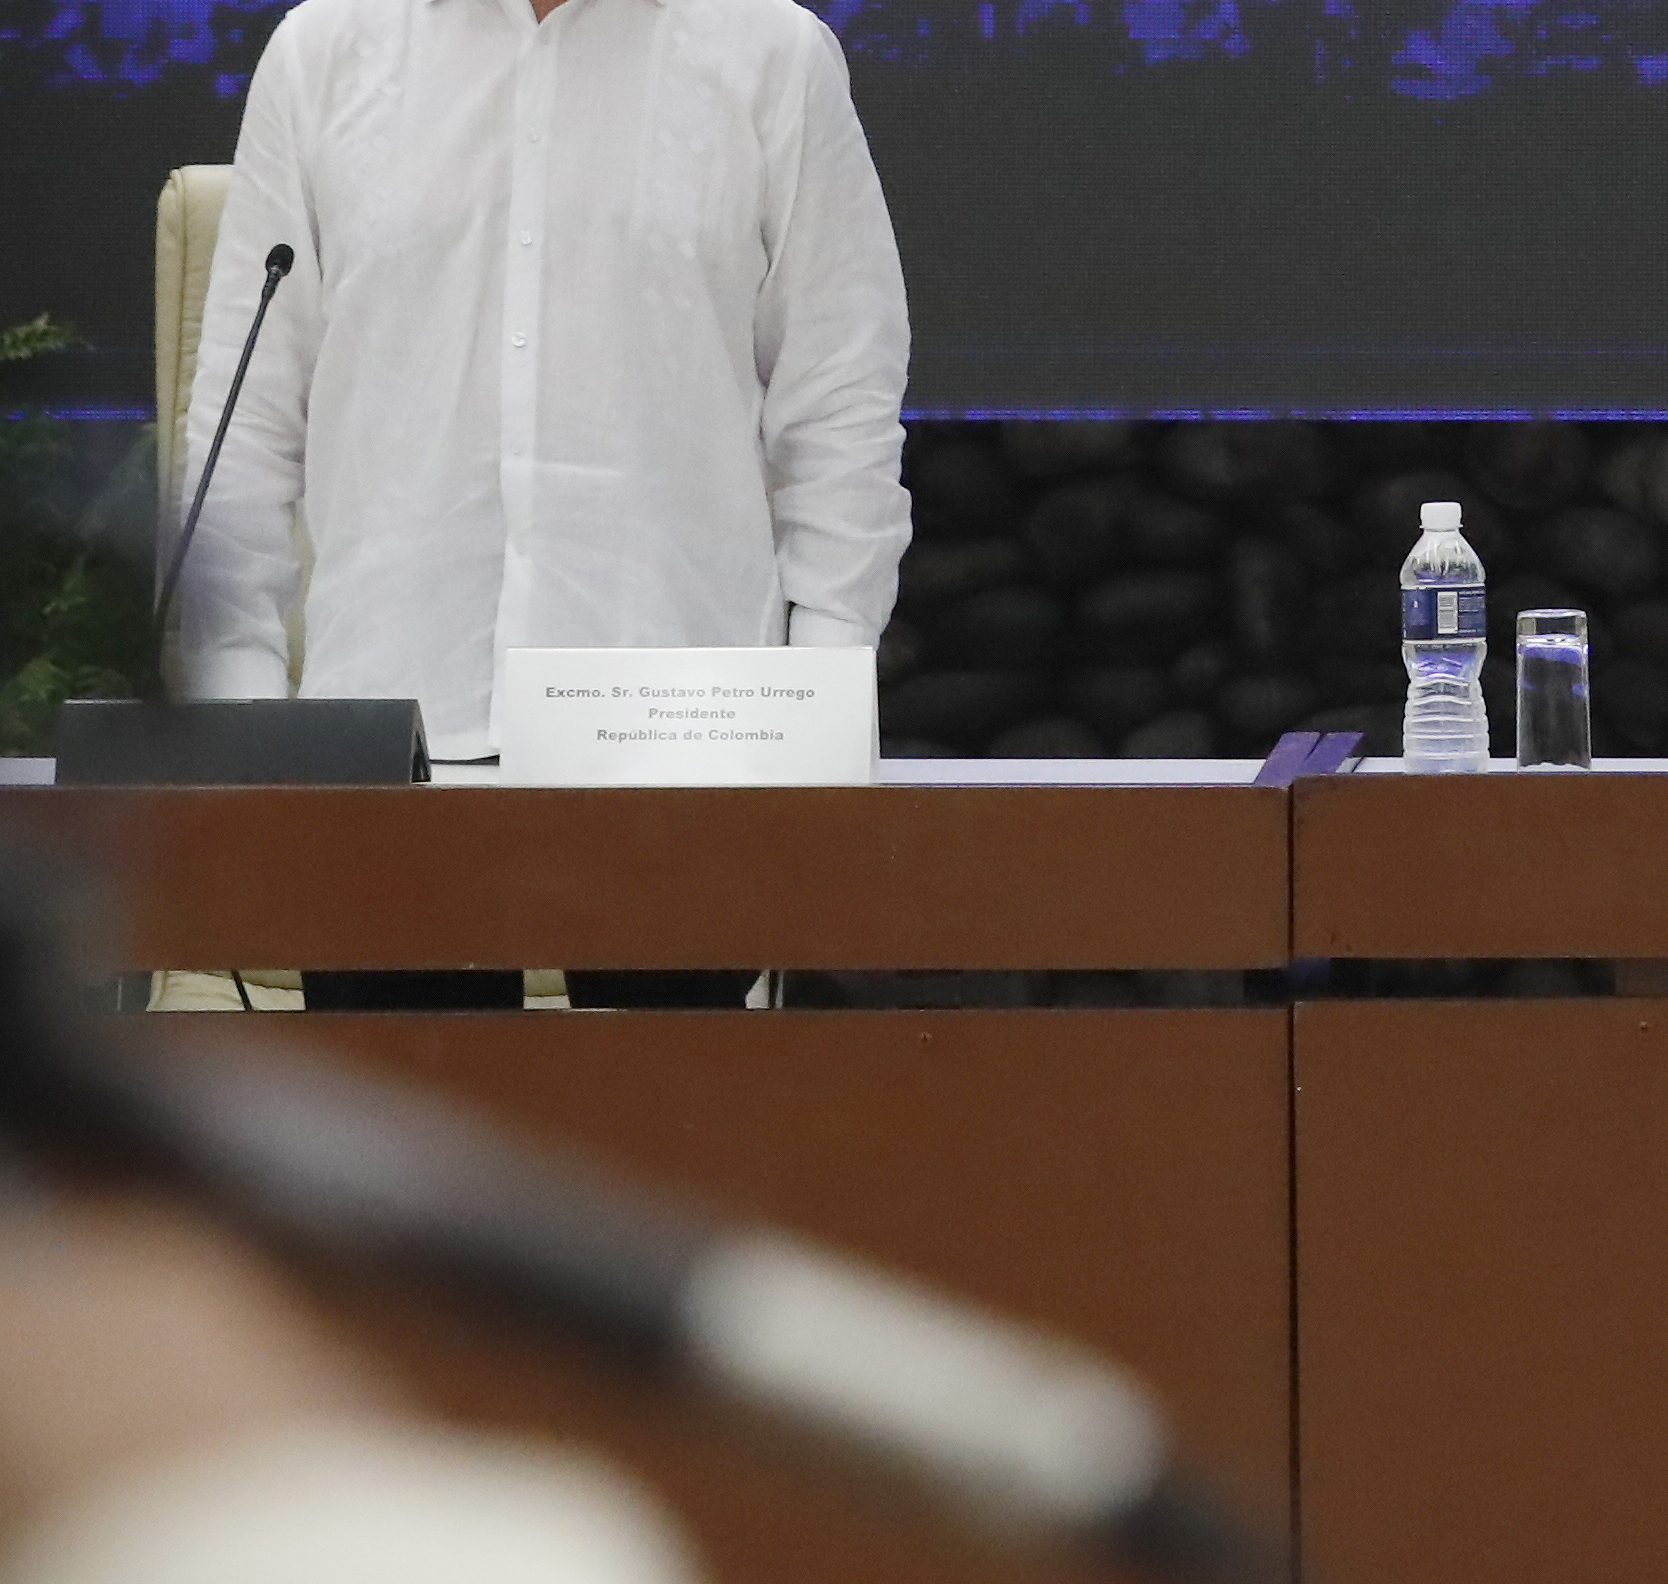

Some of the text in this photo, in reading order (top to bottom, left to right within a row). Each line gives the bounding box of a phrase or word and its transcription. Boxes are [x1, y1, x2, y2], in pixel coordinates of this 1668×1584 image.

[545, 687, 815, 700] Excmo. Sr. Gustavo Petro Urrego
[648, 708, 736, 719] Presidente
[597, 730, 784, 743] República de Colombia
